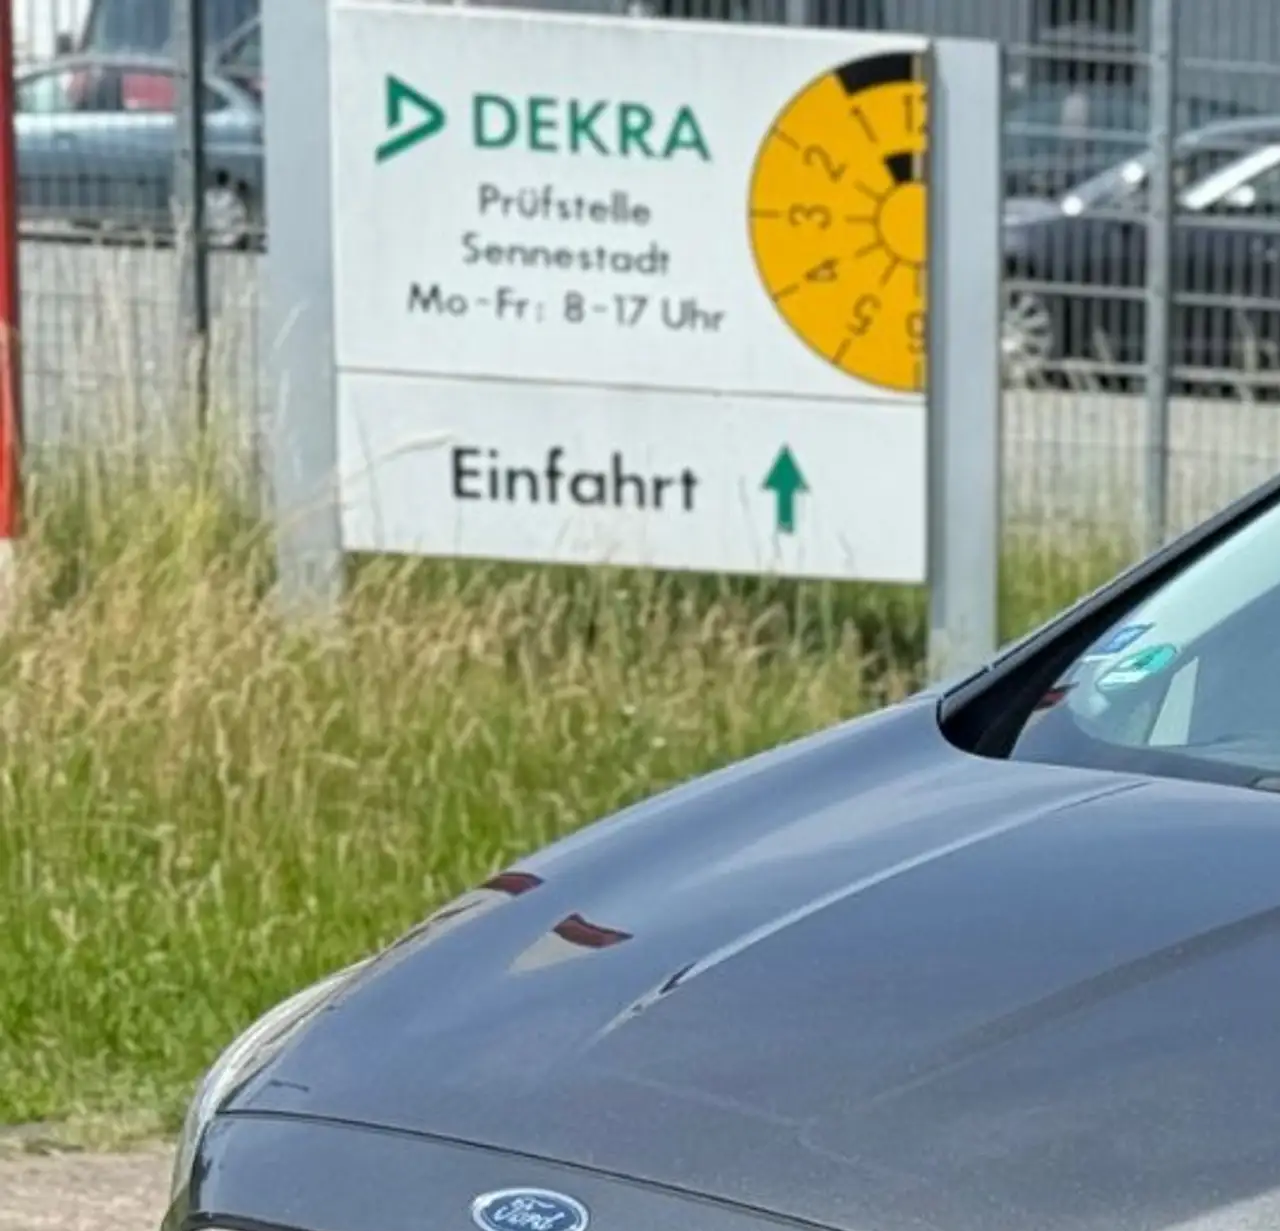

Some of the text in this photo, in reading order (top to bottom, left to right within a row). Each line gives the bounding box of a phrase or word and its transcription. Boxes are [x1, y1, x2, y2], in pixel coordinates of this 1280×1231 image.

[472, 92, 711, 162] DEKRA
[850, 106, 878, 143] 1
[803, 145, 846, 183] 2
[479, 182, 651, 226] Prüfstelle
[788, 202, 832, 230] 3
[461, 231, 670, 275] Sennestadt
[804, 257, 838, 284] 4
[660, 297, 725, 332] Uhr
[847, 293, 881, 336] 5
[452, 446, 698, 512] Einfahrt
[494, 1197, 565, 1231] Ford
